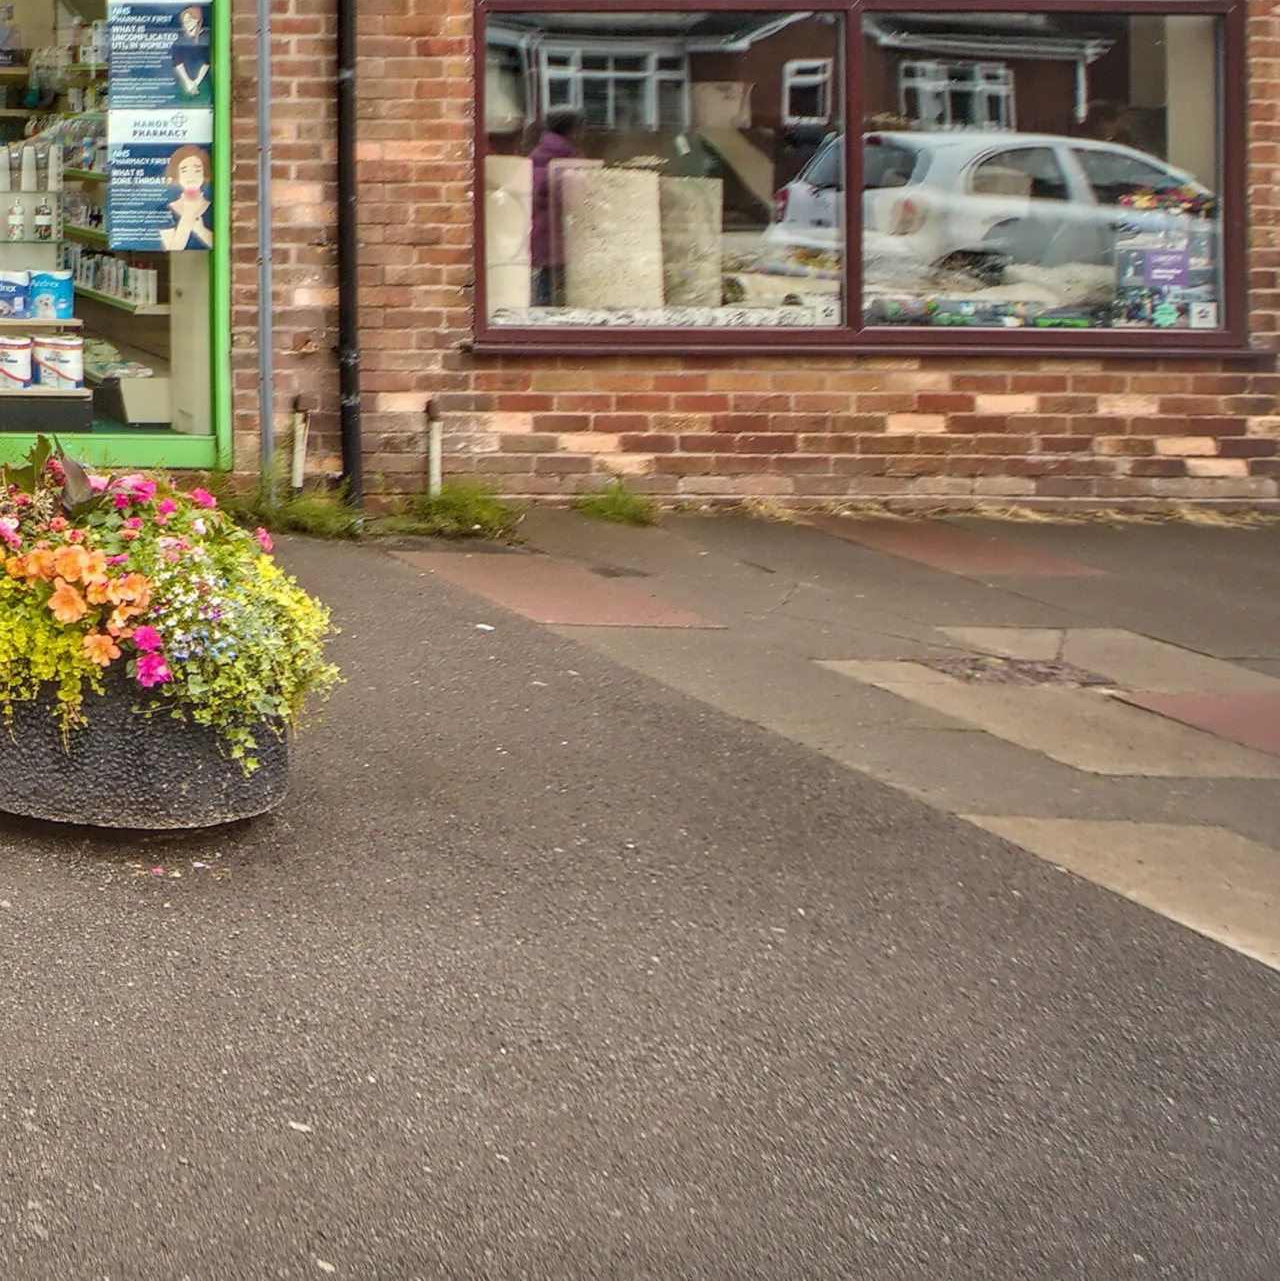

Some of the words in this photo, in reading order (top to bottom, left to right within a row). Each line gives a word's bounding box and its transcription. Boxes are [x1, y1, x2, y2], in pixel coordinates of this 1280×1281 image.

[112, 6, 132, 15] NHS
[111, 15, 151, 23] PHARMACY
[112, 25, 135, 33] WHAT
[137, 25, 146, 33] IS
[112, 33, 179, 42] UNCOMPLICATED
[133, 120, 169, 128] MANOR
[132, 129, 188, 138] PHARMACY
[112, 149, 131, 158] NHS
[112, 168, 135, 176] WHAT
[136, 168, 145, 176] IS
[111, 177, 132, 185] SORE
[134, 177, 166, 185] THROAT
[30, 278, 60, 288] Andrex
